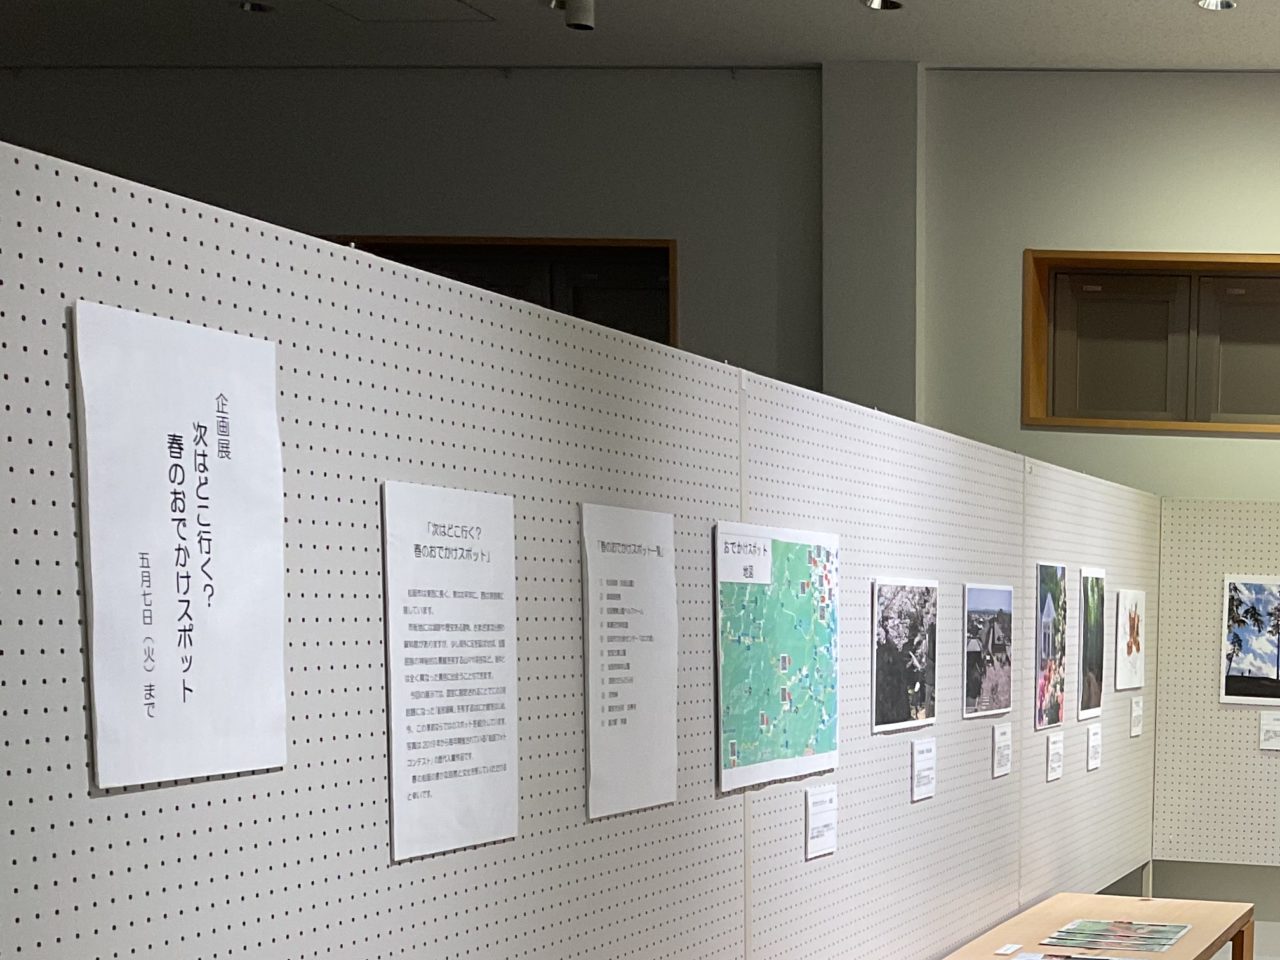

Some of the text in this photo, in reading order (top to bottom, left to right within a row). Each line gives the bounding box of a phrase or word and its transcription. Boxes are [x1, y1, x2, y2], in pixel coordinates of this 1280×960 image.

[215, 392, 231, 460] 企画展
[166, 432, 195, 704] 春のおでかけスポット
